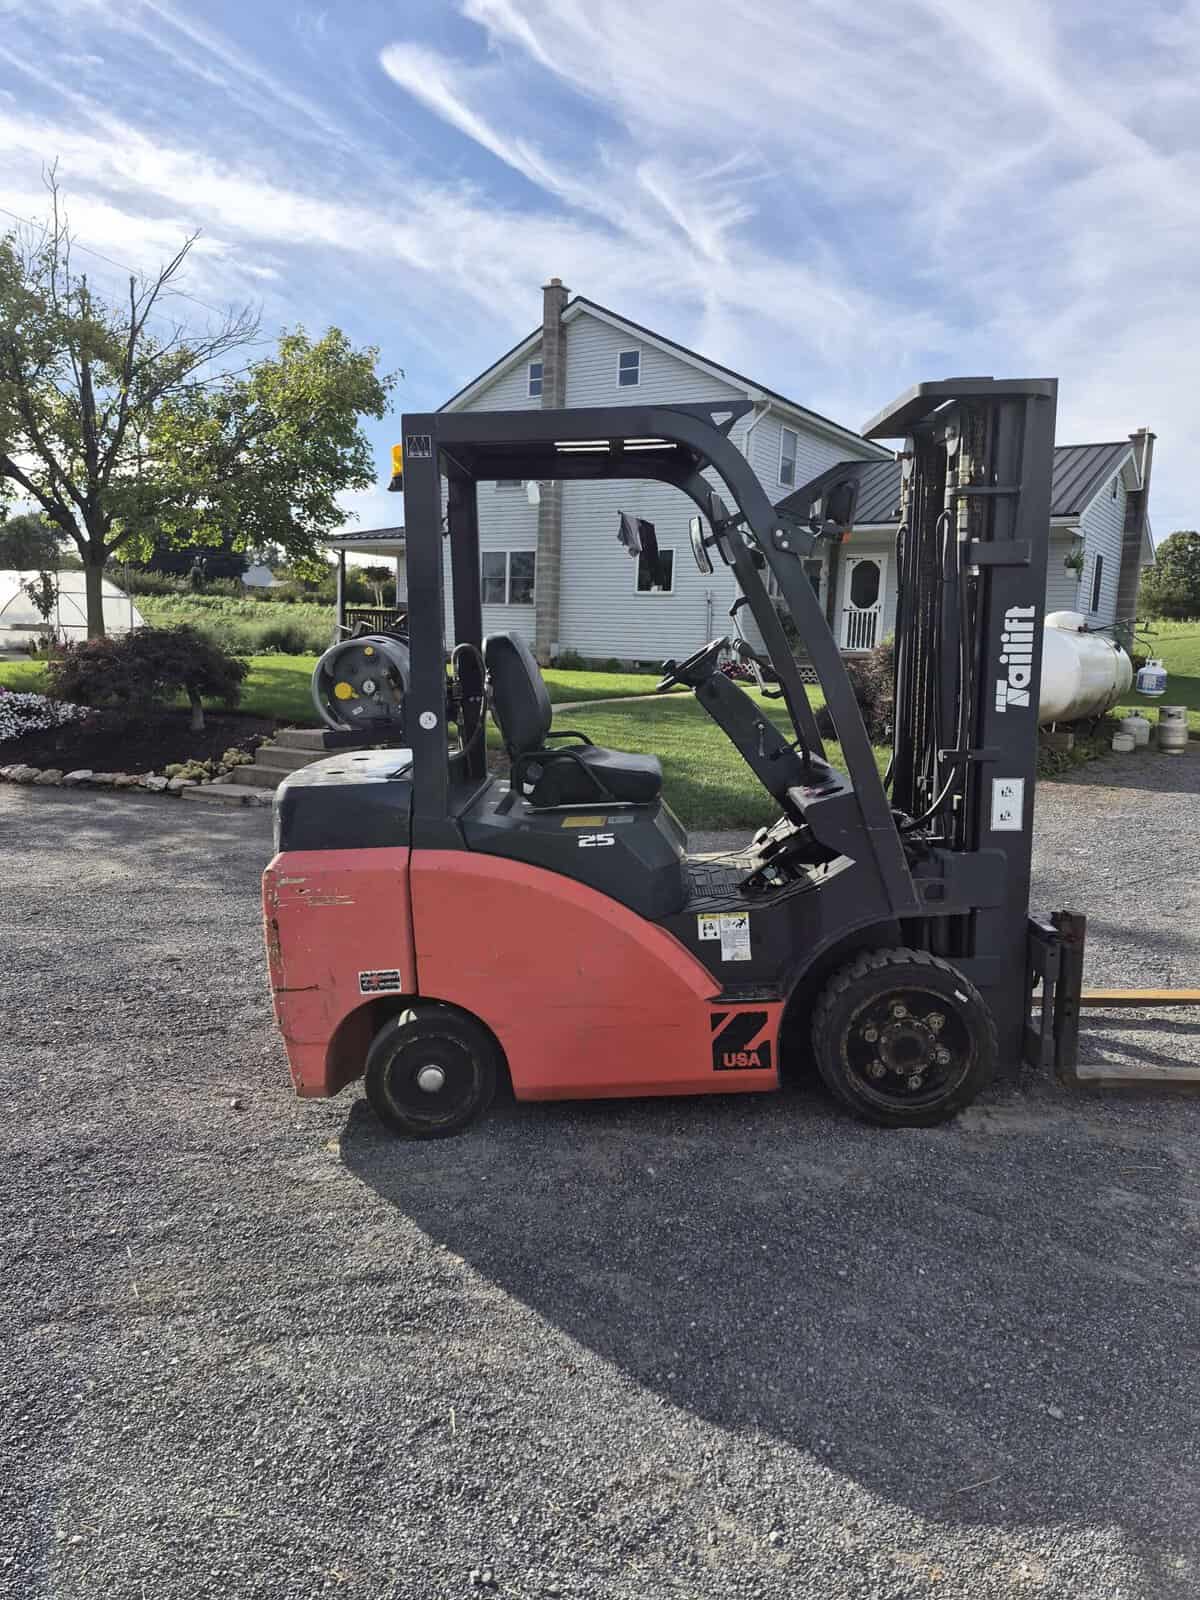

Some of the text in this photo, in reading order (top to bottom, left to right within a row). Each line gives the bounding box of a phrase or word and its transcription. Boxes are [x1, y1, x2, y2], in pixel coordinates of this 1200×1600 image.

[995, 605, 1036, 712] Tailift
[577, 832, 616, 848] 25
[722, 1051, 761, 1067] USA
